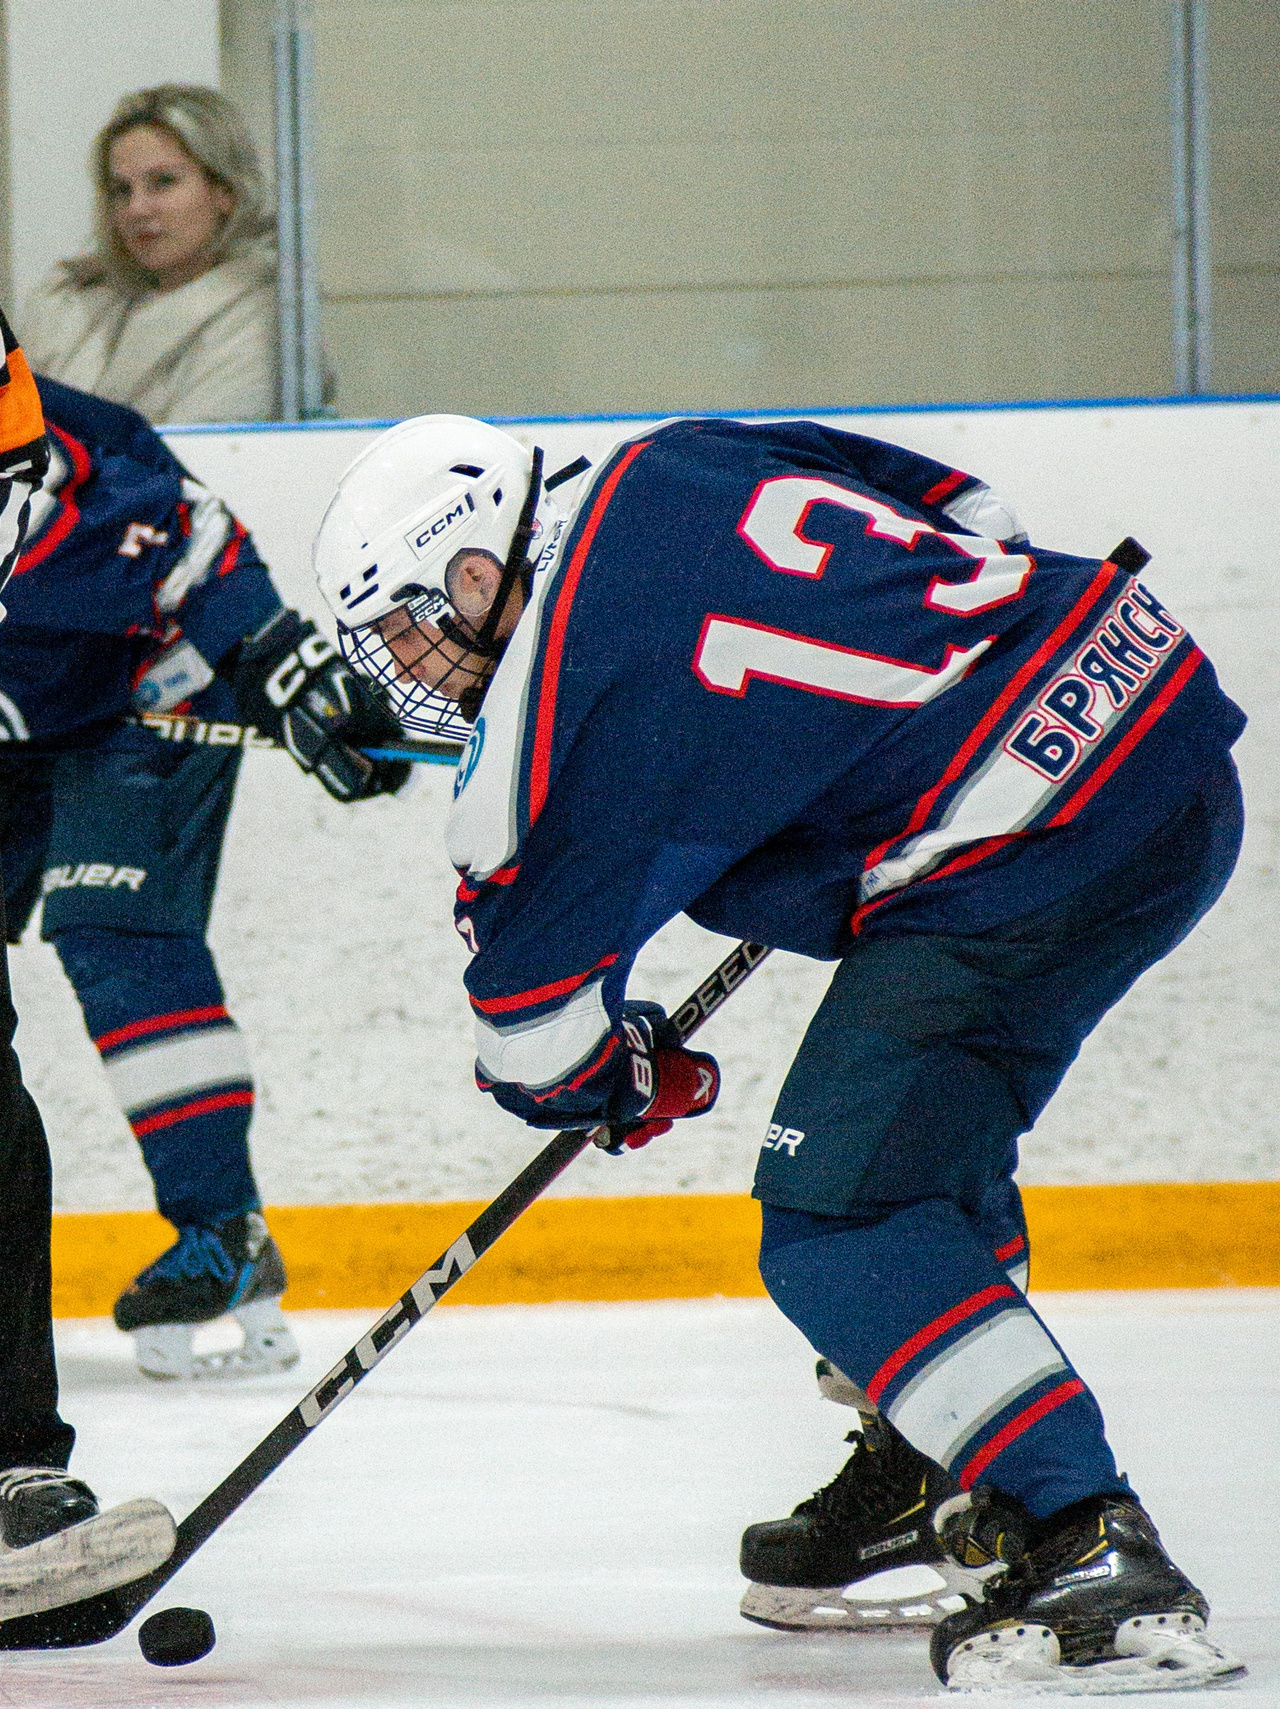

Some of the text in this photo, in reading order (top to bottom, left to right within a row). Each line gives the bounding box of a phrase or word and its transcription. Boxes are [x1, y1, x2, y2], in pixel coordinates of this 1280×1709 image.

[415, 503, 464, 548] CCM
[414, 597, 446, 623] CCM
[692, 475, 1036, 708] 13
[299, 1231, 478, 1428] CCM
